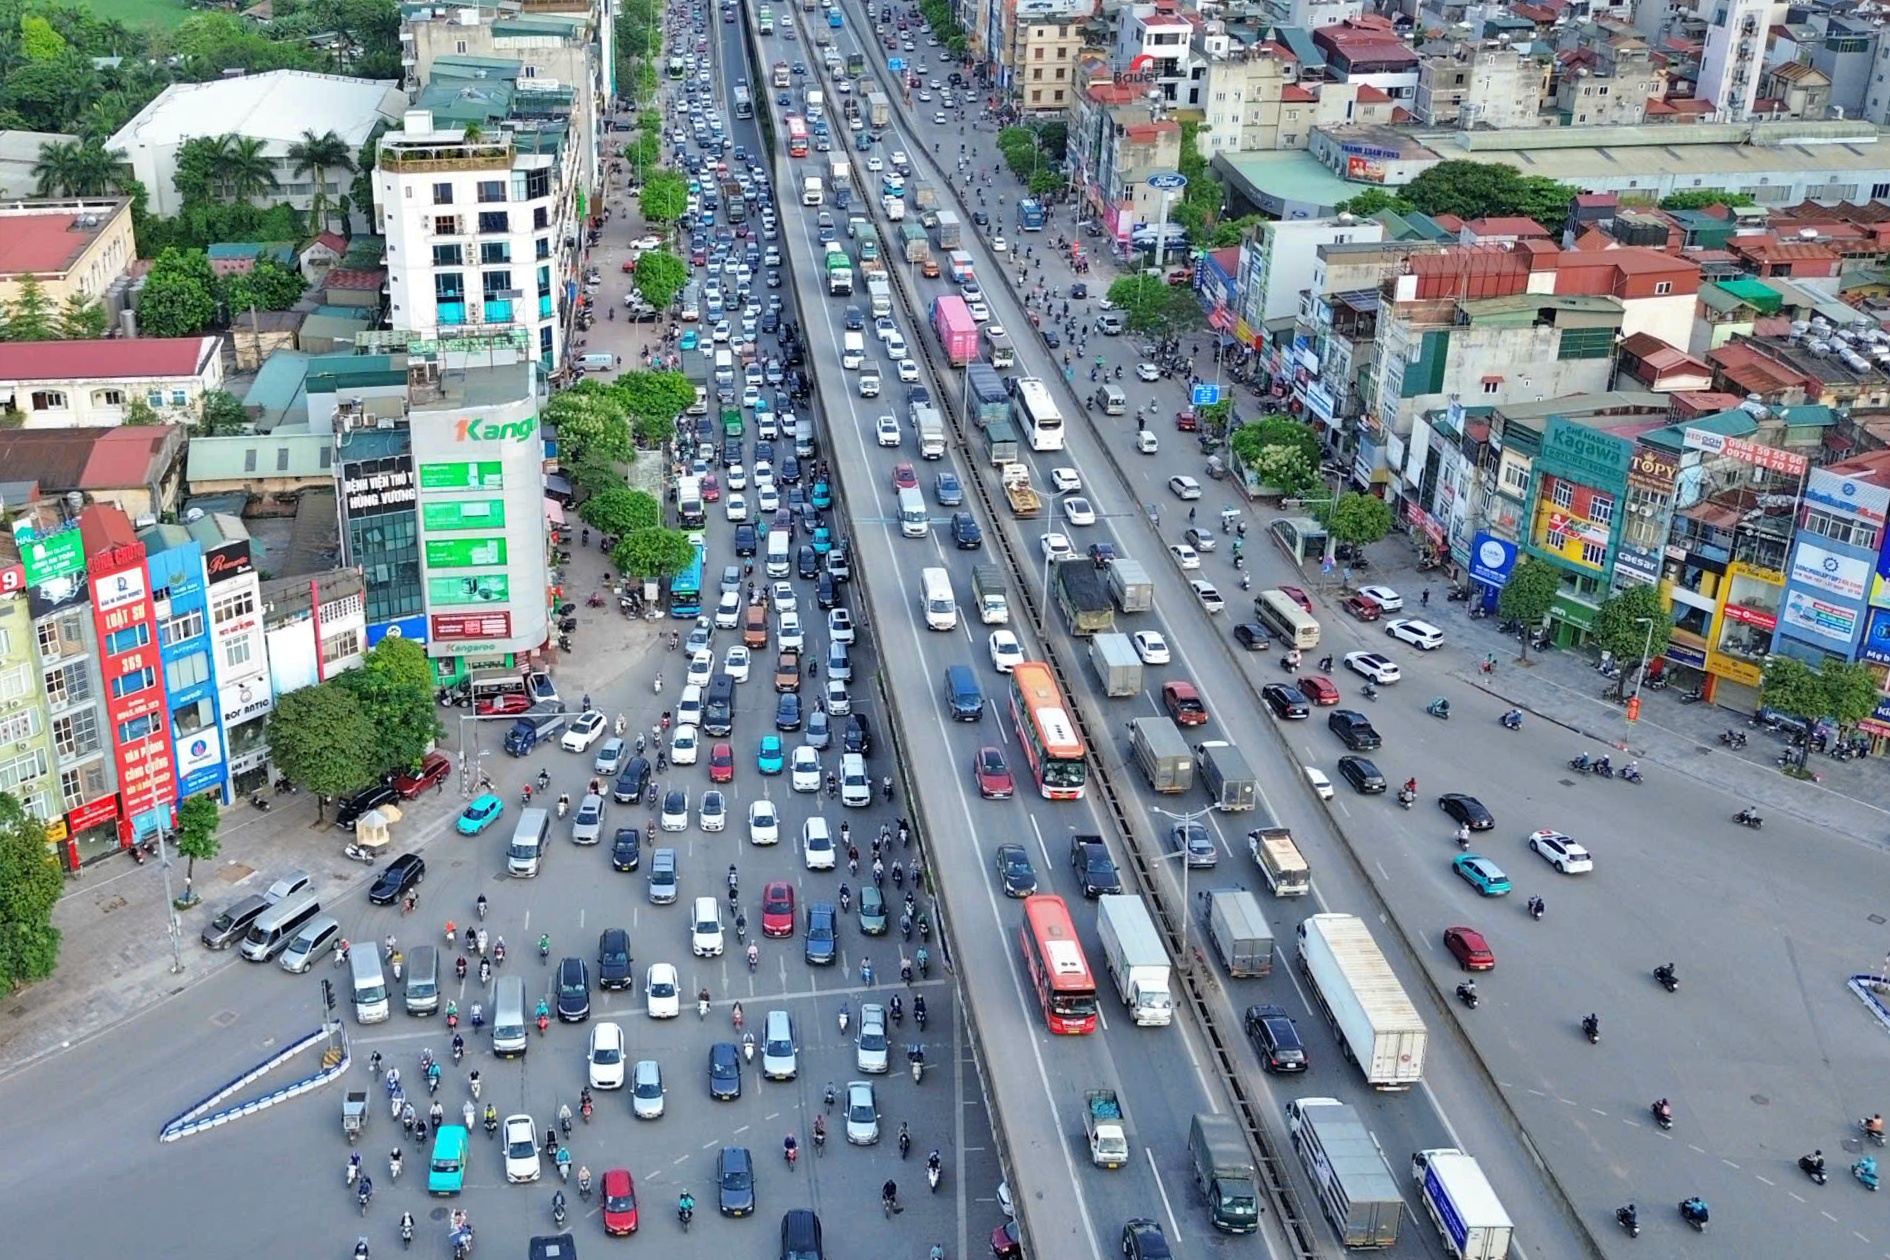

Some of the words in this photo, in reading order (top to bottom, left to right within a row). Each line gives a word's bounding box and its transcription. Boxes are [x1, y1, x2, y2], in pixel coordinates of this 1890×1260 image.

[1113, 71, 1160, 84] Bauer
[1154, 175, 1180, 187] Ford
[1553, 428, 1620, 464] Kagawa
[1728, 439, 1754, 452] 0988
[1756, 446, 1770, 456] 59
[1774, 450, 1786, 461] 55
[1789, 454, 1803, 465] 66
[1631, 456, 1676, 480] TOPY
[1726, 448, 1752, 461] 0978
[1755, 455, 1767, 466] 91
[1771, 459, 1784, 470] 70
[1788, 463, 1801, 474] 75
[345, 478, 369, 494] BỆNH
[370, 474, 389, 491] VIỆN
[390, 471, 407, 487] THÚ
[350, 493, 378, 509] HÙNG
[381, 489, 416, 504] VƯƠNG
[1618, 550, 1657, 571] caesar
[2, 571, 18, 590] 9
[105, 608, 128, 630] LUẬT
[131, 601, 146, 621] SƯ
[446, 643, 495, 653] Kangaroo
[122, 654, 143, 673] 369
